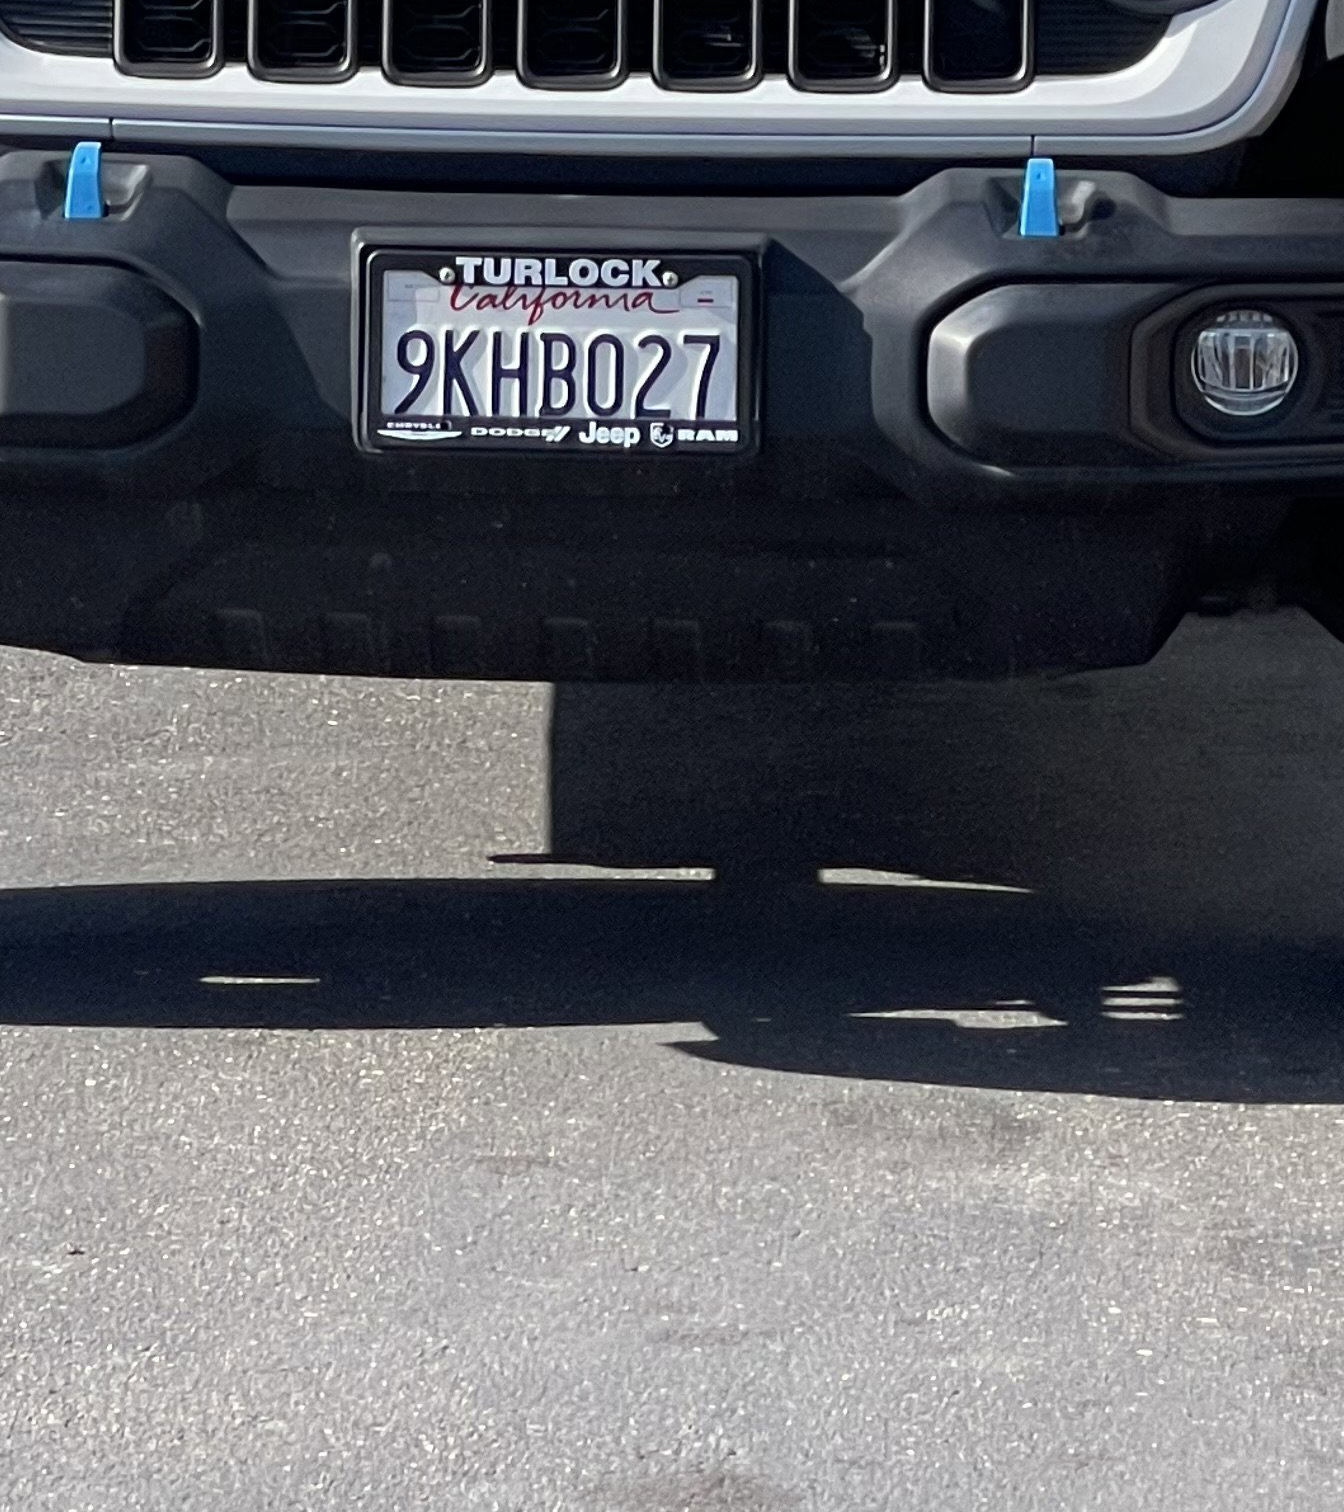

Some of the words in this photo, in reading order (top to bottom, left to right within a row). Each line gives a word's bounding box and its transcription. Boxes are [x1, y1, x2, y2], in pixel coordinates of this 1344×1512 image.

[456, 256, 662, 287] TURLOCK
[450, 285, 680, 326] California
[393, 329, 720, 420] 9KHB027
[471, 427, 555, 438] DODGE
[579, 421, 641, 448] Jeep
[678, 429, 738, 442] RAM
